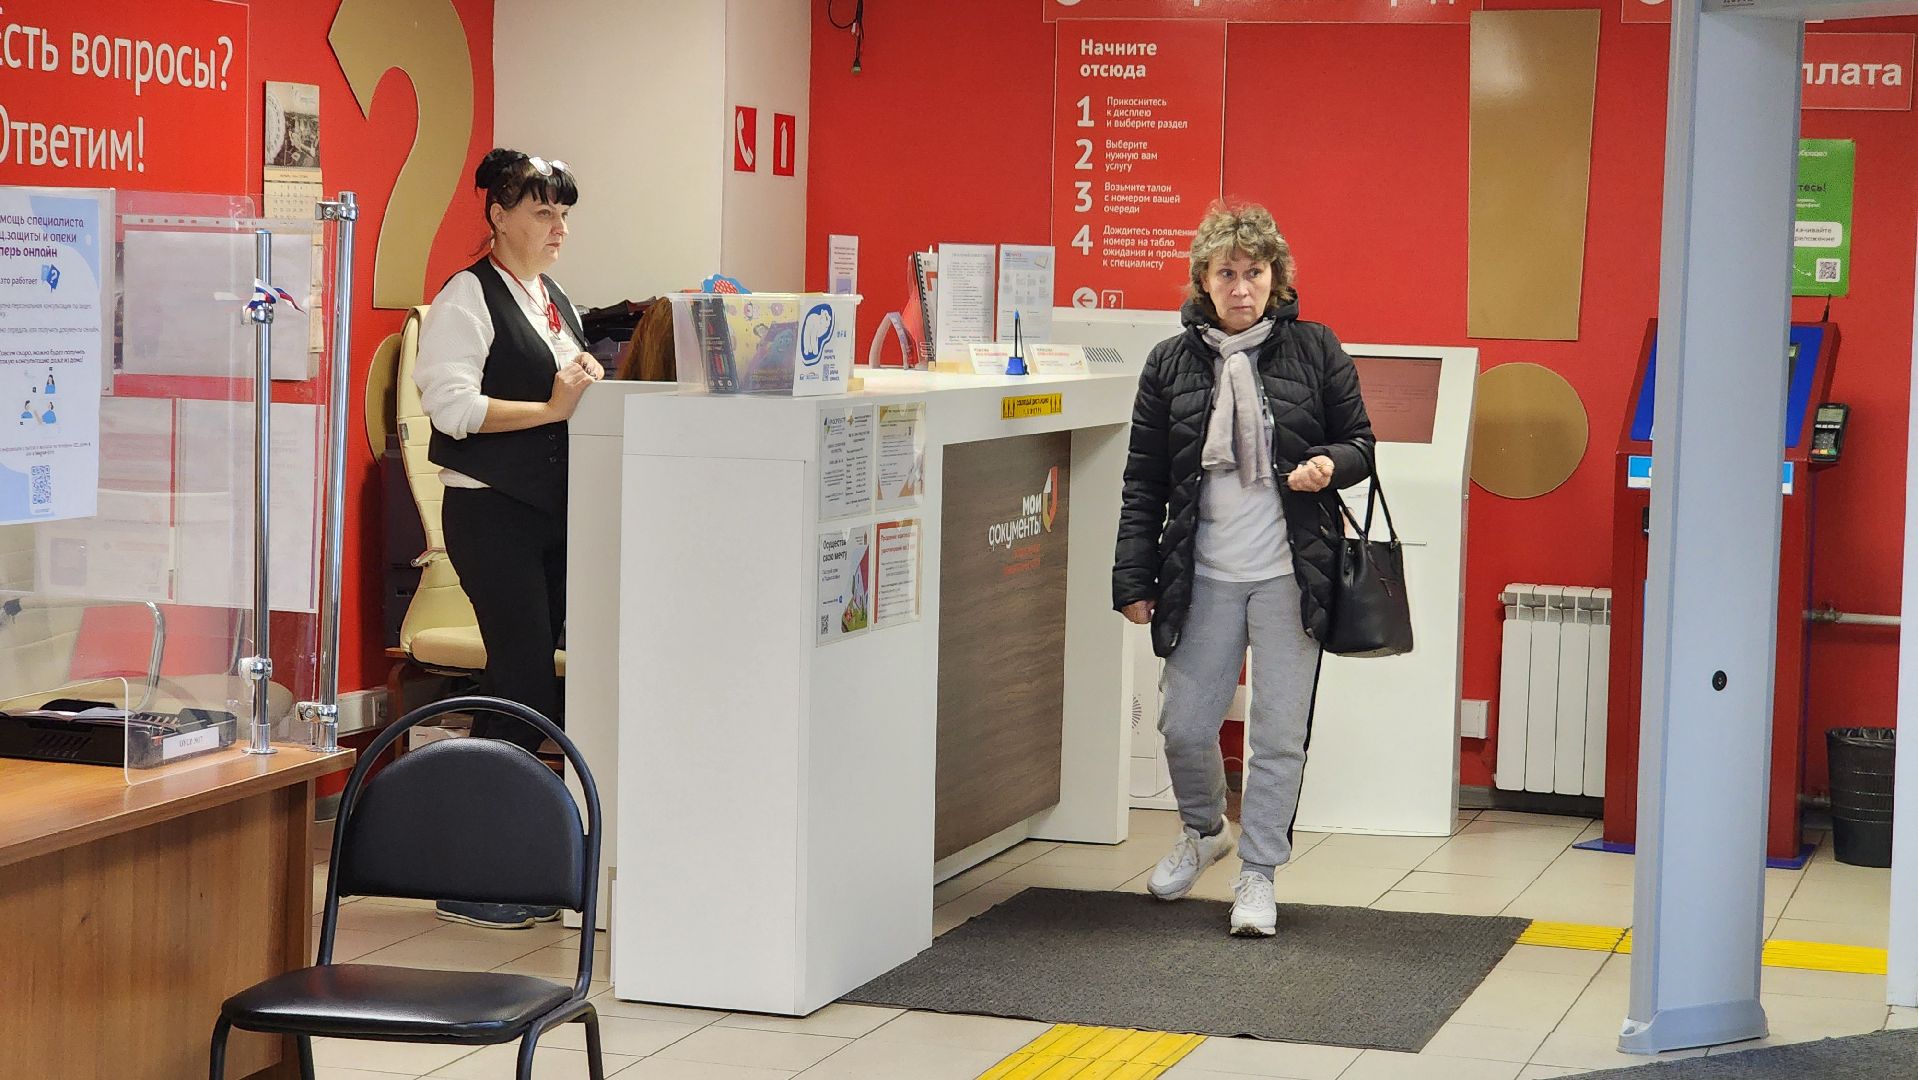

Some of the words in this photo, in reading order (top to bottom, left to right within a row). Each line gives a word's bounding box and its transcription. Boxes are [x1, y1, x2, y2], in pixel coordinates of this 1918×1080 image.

[1081, 39, 1157, 56] Начните
[0, 24, 59, 72] сть
[72, 33, 233, 96] вопросы?
[1080, 64, 1146, 80] отсюда
[1077, 96, 1094, 127] 1
[1107, 96, 1167, 107] Прикоснитесь
[1114, 109, 1151, 118] дисплею
[1114, 119, 1154, 129] выберите
[1158, 121, 1188, 129] раздел
[1075, 139, 1093, 169] 2
[1105, 139, 1148, 150] Выберите
[1105, 151, 1138, 161] нужную
[1142, 152, 1158, 160] вам
[1105, 163, 1132, 172] услугу
[1075, 181, 1093, 213] 3
[1104, 181, 1145, 192] Возьмите
[1147, 184, 1172, 193] талон
[1111, 195, 1150, 203] номером
[1152, 194, 1180, 203] вашей
[1103, 205, 1140, 214] очереди
[27, 217, 84, 228] специалиста
[50, 234, 77, 243] опеки
[1071, 224, 1093, 255] 4
[1103, 225, 1150, 236] Дождитесь
[1103, 237, 1136, 248] номера
[1138, 239, 1148, 247] на
[1150, 237, 1175, 247] табло
[23, 246, 58, 258] онлайн
[1103, 248, 1146, 257] ожидания
[1110, 260, 1164, 270] специалисту
[1022, 492, 1042, 516] мои
[988, 516, 1042, 551] документы
